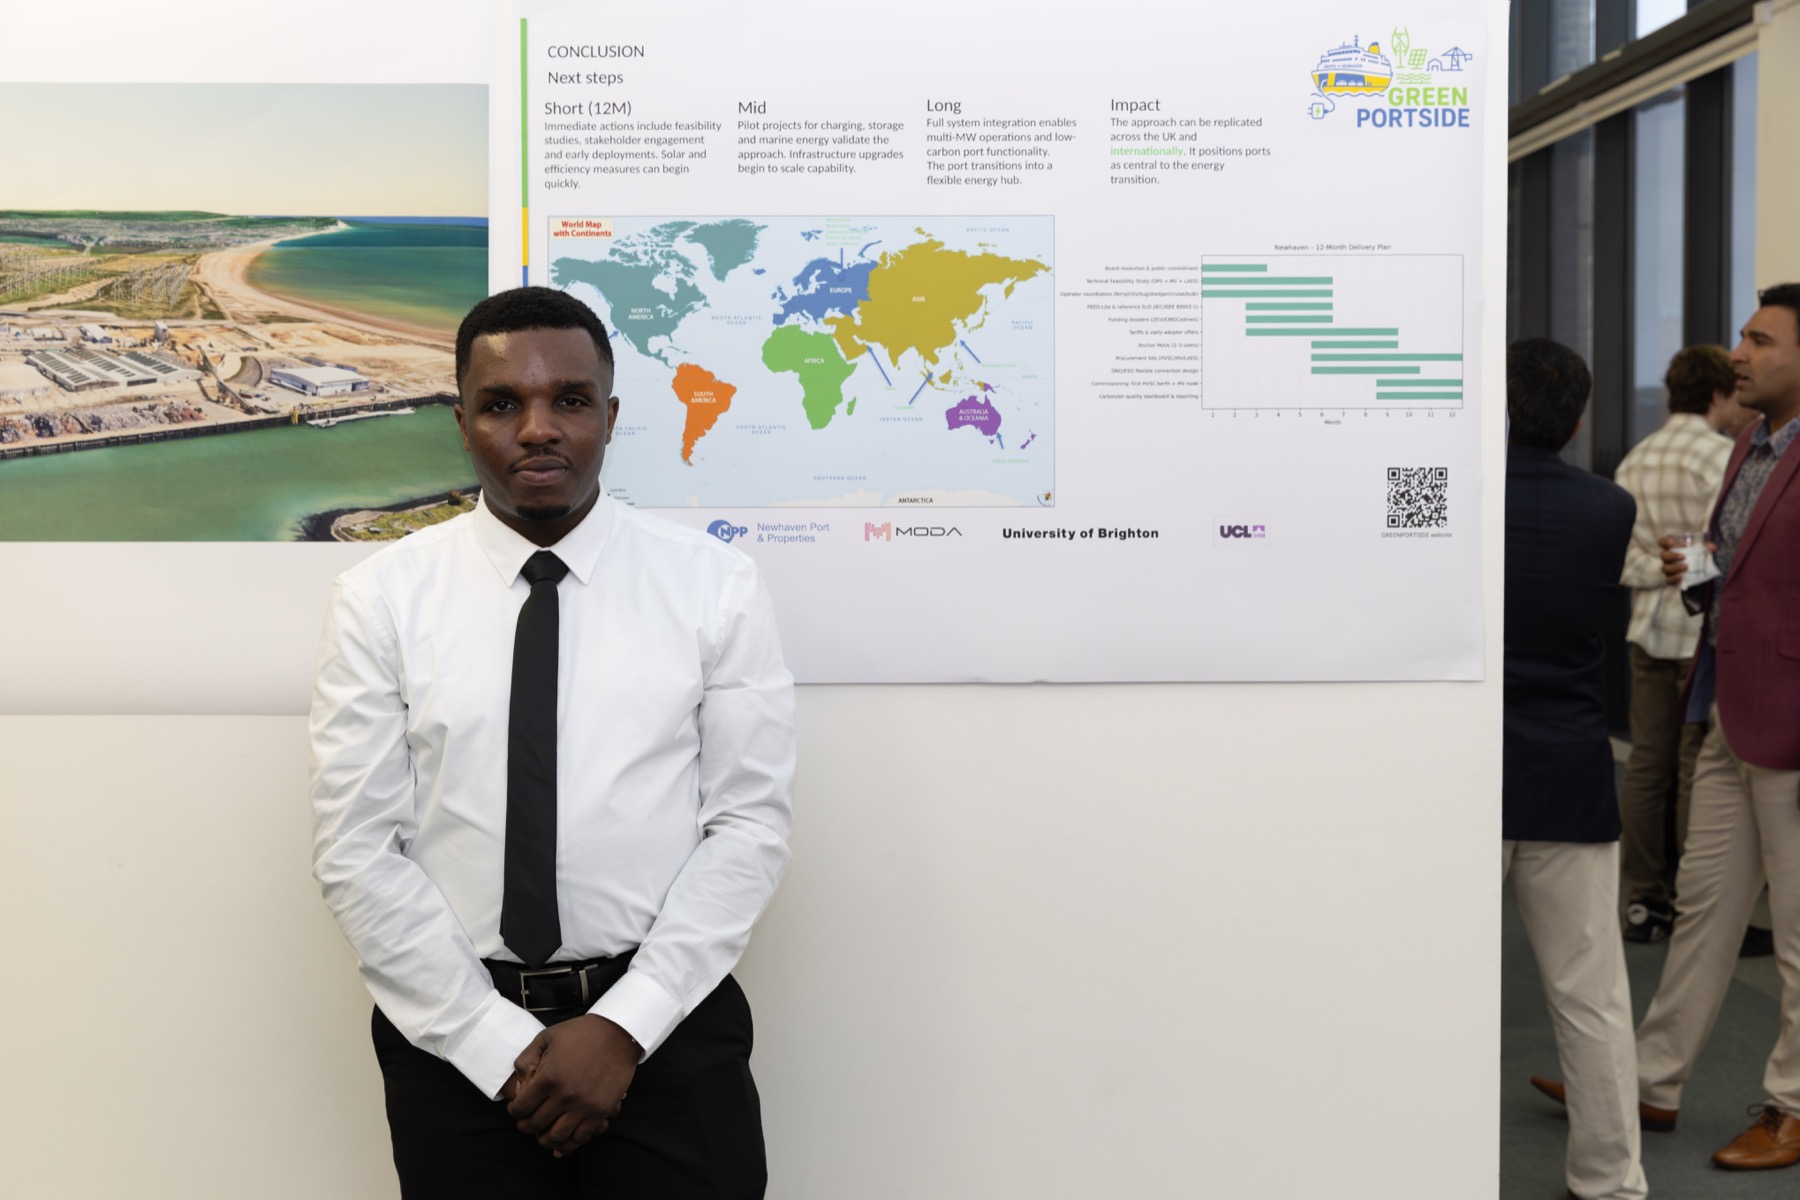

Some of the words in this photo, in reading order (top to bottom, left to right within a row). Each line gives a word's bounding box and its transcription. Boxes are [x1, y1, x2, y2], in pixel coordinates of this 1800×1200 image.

[547, 45, 644, 58] CONCLUSION
[548, 72, 581, 84] Next
[586, 72, 624, 87] steps
[1387, 86, 1468, 107] GREEN
[544, 101, 584, 115] Short
[588, 100, 632, 117] (12M)
[738, 100, 766, 114] Mid
[927, 99, 962, 115] Long
[1111, 98, 1161, 114] Impact
[926, 118, 944, 128] Full
[946, 119, 980, 129] system
[983, 118, 1036, 129] integration
[1038, 117, 1077, 127] enables
[1110, 117, 1129, 127] The
[1130, 117, 1177, 128] approach
[1179, 119, 1196, 127] can
[1198, 117, 1212, 127] be
[1214, 117, 1262, 128] replicated
[1356, 108, 1470, 128] PORTSIDE
[544, 121, 597, 131] Immediate
[600, 121, 634, 131] actions
[637, 121, 672, 131] include
[675, 120, 722, 132] feasibility
[738, 120, 760, 130] Pilot
[762, 120, 802, 132] projects
[804, 120, 818, 130] for
[820, 120, 866, 132] charging,
[868, 121, 904, 132] storage
[544, 135, 582, 145] studies,
[584, 135, 642, 145] stakeholder
[644, 136, 704, 146] engagement
[738, 135, 756, 144] and
[759, 135, 794, 144] marine
[796, 137, 830, 146] energy
[832, 135, 870, 144] validate
[872, 135, 890, 144] the
[926, 132, 977, 142] multi-MW
[978, 132, 1032, 143] operations
[1034, 132, 1052, 142] and
[1110, 134, 1141, 142] across
[1143, 132, 1160, 142] the
[1178, 132, 1197, 142] and
[544, 150, 563, 160] and
[565, 149, 590, 161] early
[592, 150, 658, 161] deployments.
[661, 149, 686, 159] Solar
[688, 148, 707, 159] and
[738, 149, 786, 160] approach.
[789, 149, 856, 159] Infrastructure
[858, 149, 904, 161] upgrades
[926, 147, 961, 156] carbon
[963, 148, 984, 158] port
[986, 146, 1050, 158] functionality.
[1110, 146, 1186, 156] internationally.
[1198, 146, 1243, 158] positions
[1245, 147, 1271, 157] ports
[544, 164, 591, 175] efficiency
[593, 166, 640, 174] measures
[642, 166, 660, 174] can
[662, 164, 690, 176] begin
[738, 163, 765, 175] begin
[780, 163, 805, 173] scale
[807, 163, 856, 175] capability.
[926, 161, 945, 171] The
[948, 161, 968, 172] port
[971, 160, 1022, 170] transitions
[1025, 160, 1044, 170] into
[1123, 160, 1157, 170] central
[1172, 160, 1189, 170] the
[1191, 162, 1225, 172] energy
[544, 178, 580, 190] quickly.
[964, 177, 998, 187] energy
[1000, 175, 1022, 185] hub.
[1110, 174, 1160, 184] transition.
[561, 220, 584, 228] World
[585, 220, 602, 230] Map
[553, 230, 570, 238] with
[571, 230, 612, 238] Continents
[803, 357, 825, 365] AFRICA
[719, 525, 749, 538] NPP
[756, 522, 809, 532] Newhaven
[810, 522, 830, 532] Port
[896, 526, 962, 536] MODA
[1218, 524, 1252, 539] UCL
[767, 533, 816, 544] Properties
[1002, 528, 1076, 540] University
[1080, 528, 1094, 538] of
[1098, 528, 1159, 541] Brighton
